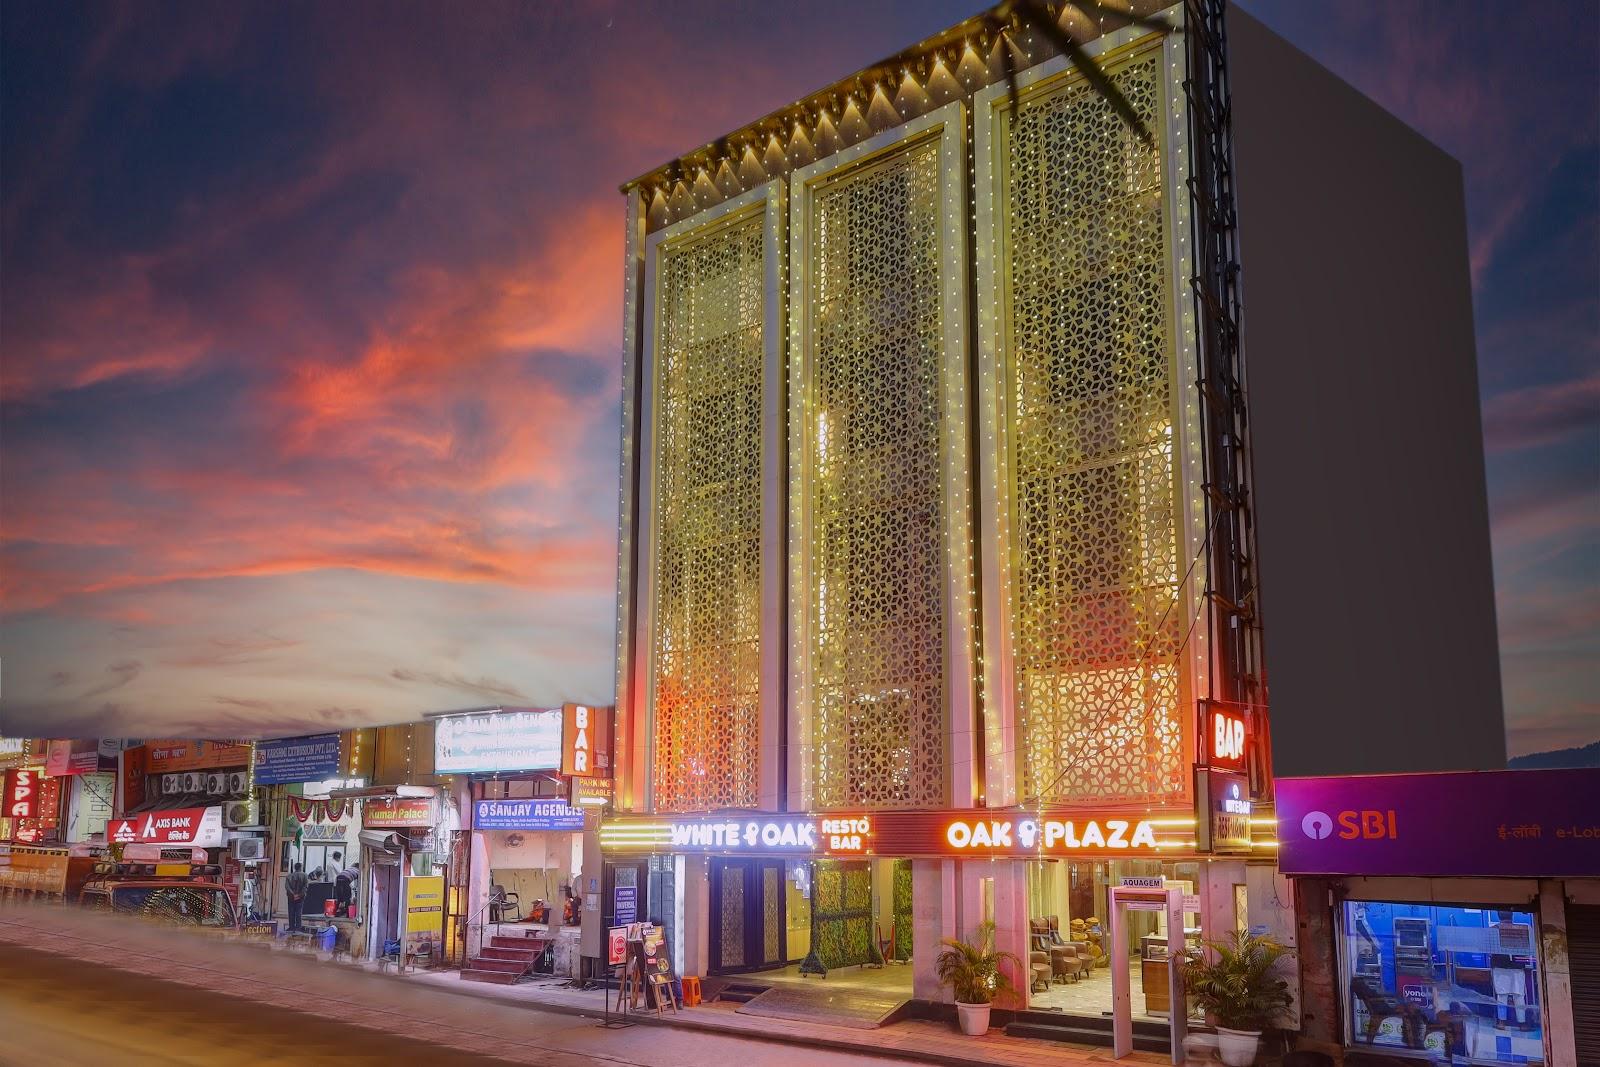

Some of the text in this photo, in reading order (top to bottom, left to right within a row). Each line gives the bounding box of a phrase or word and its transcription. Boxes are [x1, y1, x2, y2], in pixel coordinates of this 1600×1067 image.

[575, 706, 588, 772] BAR
[1215, 713, 1245, 760] BAR
[579, 779, 609, 787] PARKING
[12, 771, 31, 816] SPA
[368, 808, 428, 819] Kumar Palace
[489, 803, 585, 817] SANJAY AGENCIE
[156, 817, 191, 828] AXIS BANK
[821, 819, 869, 834] RESTO
[1337, 810, 1397, 840] SBI
[671, 822, 814, 847] WHITE OAK
[947, 820, 1157, 848] OAK PLAZA
[1498, 824, 1542, 840] ई-लॉबी
[830, 835, 861, 850] BAR
[1123, 879, 1160, 887] AQUAGEM
[245, 924, 272, 934] ection
